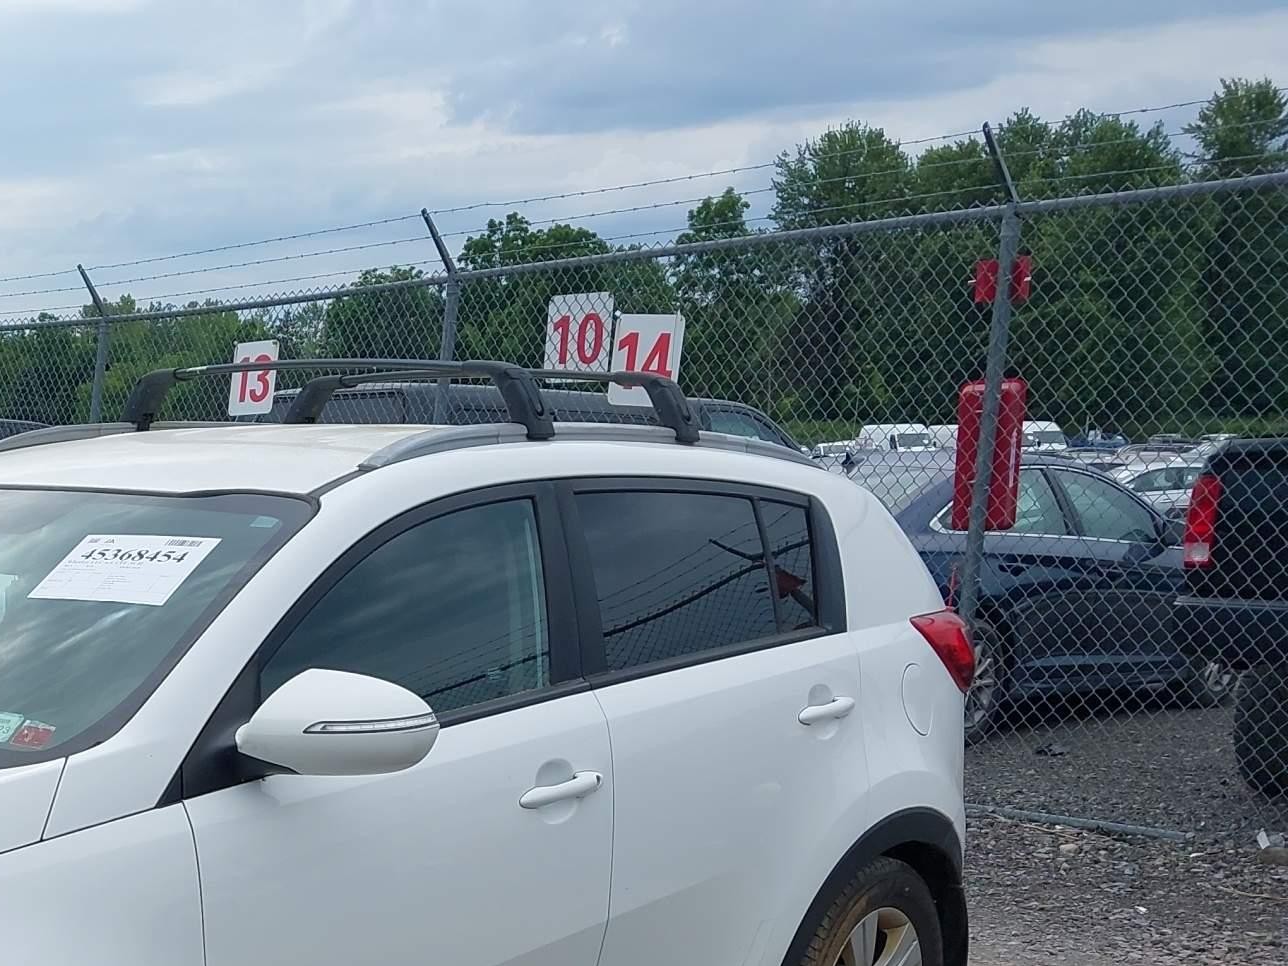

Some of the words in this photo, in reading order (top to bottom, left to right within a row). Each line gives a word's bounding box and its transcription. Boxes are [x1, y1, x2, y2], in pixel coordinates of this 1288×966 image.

[553, 312, 603, 365] 10
[618, 331, 672, 389] 14
[238, 354, 272, 403] 13
[81, 548, 190, 563] 45368454
